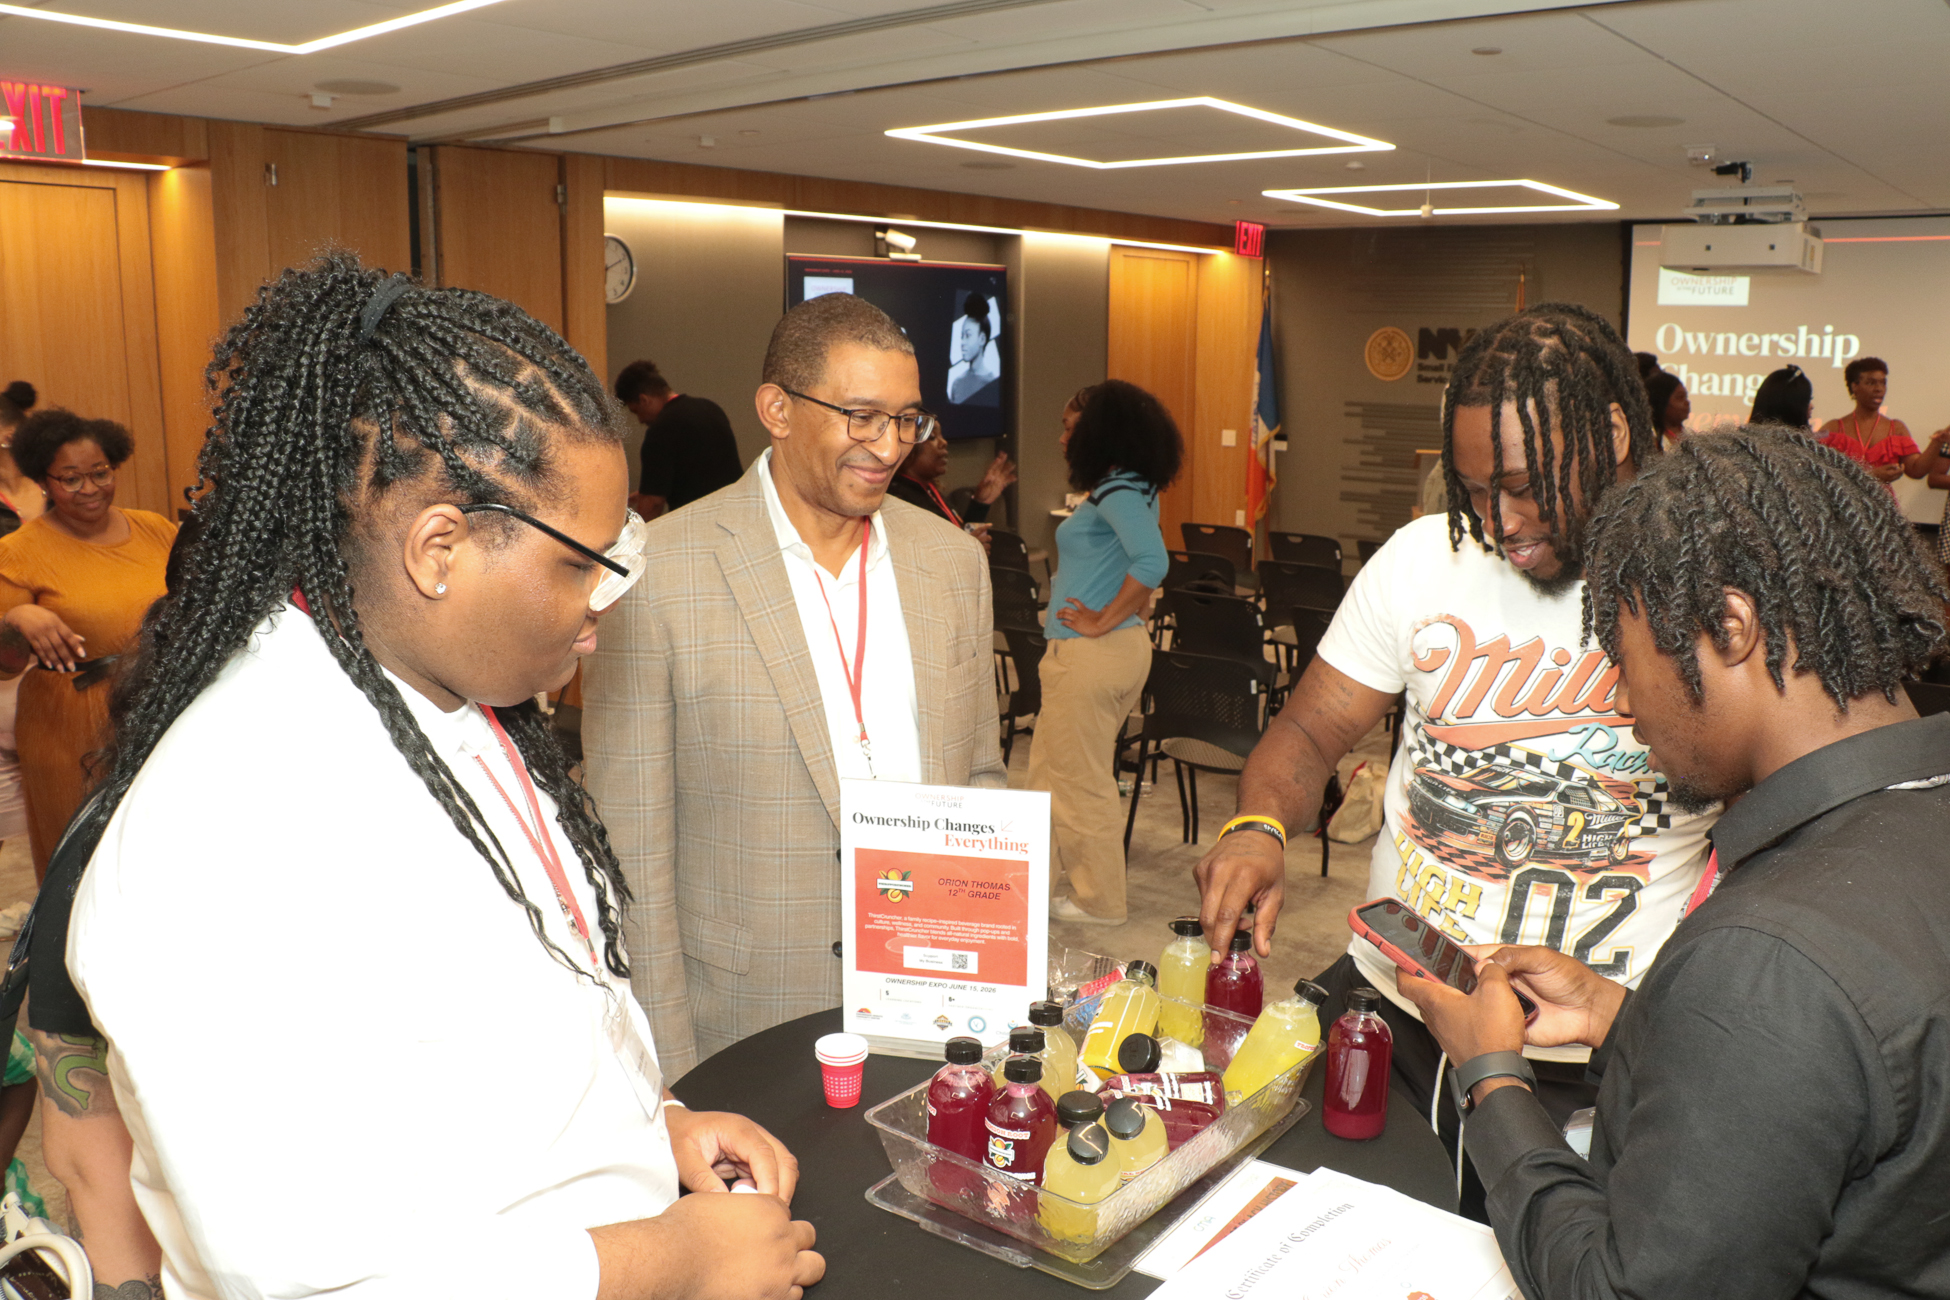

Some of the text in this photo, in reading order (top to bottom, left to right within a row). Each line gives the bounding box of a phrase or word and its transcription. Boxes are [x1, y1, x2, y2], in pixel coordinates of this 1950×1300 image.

[0, 81, 67, 155] XIT
[1239, 221, 1264, 256] EXIT
[1671, 276, 1737, 286] OWNERSHIP
[1692, 286, 1735, 295] FUTURE
[1655, 322, 1860, 368] Ownership
[1660, 363, 1768, 406] hang
[1411, 613, 1620, 719] Mill
[914, 792, 965, 802] OWNERSHIP
[931, 800, 963, 809] FUTURE
[852, 811, 996, 836] Ownership Changes
[1584, 812, 1629, 826] Miller
[1562, 811, 1585, 848] 2
[944, 833, 1029, 855] Everything
[1582, 834, 1613, 843] HIGH
[1394, 830, 1484, 920] HIGH
[938, 877, 1011, 891] ORION THOMAS
[967, 890, 1001, 901] GRADE
[908, 916, 922, 924] family
[958, 920, 980, 928] beverage
[1497, 864, 1648, 979] 02
[895, 926, 930, 935] ThirstCruncher
[947, 930, 970, 938] all-natural
[970, 932, 996, 940] ingredients
[961, 926, 979, 934] through
[938, 935, 959, 943] everyday
[885, 977, 928, 988] OWNERSHIP
[929, 981, 948, 989] EXPO
[980, 986, 997, 994] 2026
[1007, 1131, 1029, 1139] ROOT
[1224, 1253, 1283, 1300] Certificate
[1279, 1241, 1293, 1254] of
[1287, 1202, 1356, 1243] Completion
[1338, 1237, 1392, 1275] Thomas
